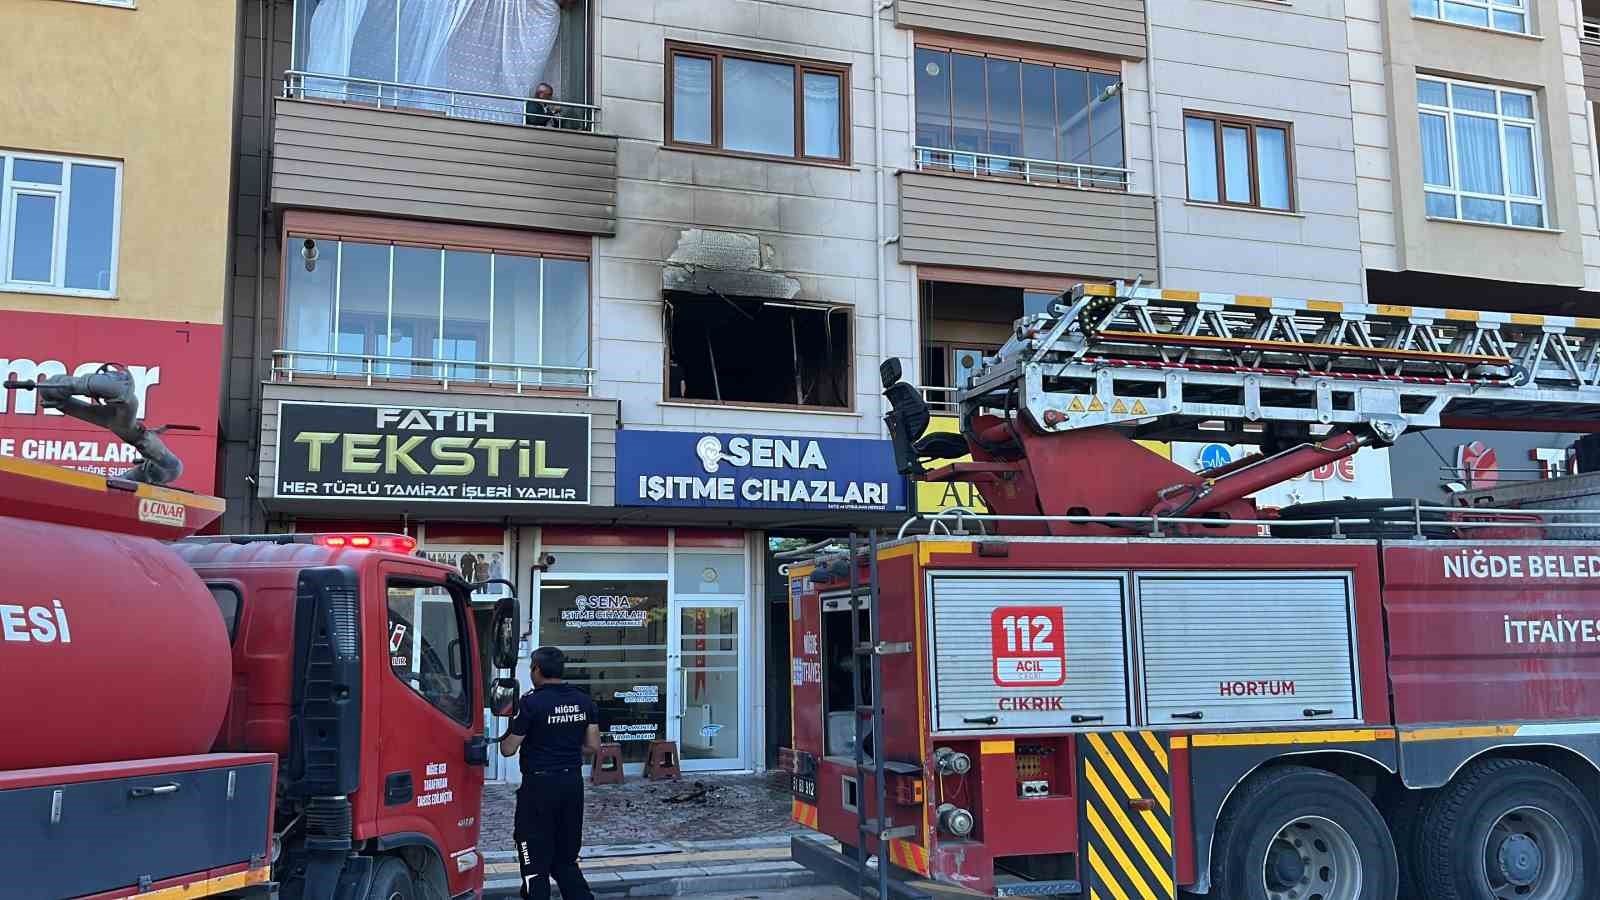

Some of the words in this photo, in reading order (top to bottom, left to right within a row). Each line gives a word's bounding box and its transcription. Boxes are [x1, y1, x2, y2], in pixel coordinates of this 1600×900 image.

[0, 359, 160, 419] mr
[376, 408, 495, 432] FATİH
[293, 431, 570, 479] TEKSTİL
[728, 437, 827, 470] SENA
[283, 480, 318, 494] HER
[322, 480, 381, 495] TÜRLÜ
[384, 482, 457, 497] TAMİRAT
[462, 483, 512, 499] İŞLERİ
[516, 486, 576, 499] YAPILIR
[1443, 549, 1524, 578] NİĞDE
[590, 595, 631, 608] SENA
[1002, 616, 1054, 652] 112
[1219, 680, 1295, 696] HORTUM
[554, 704, 581, 714] NİĞDE
